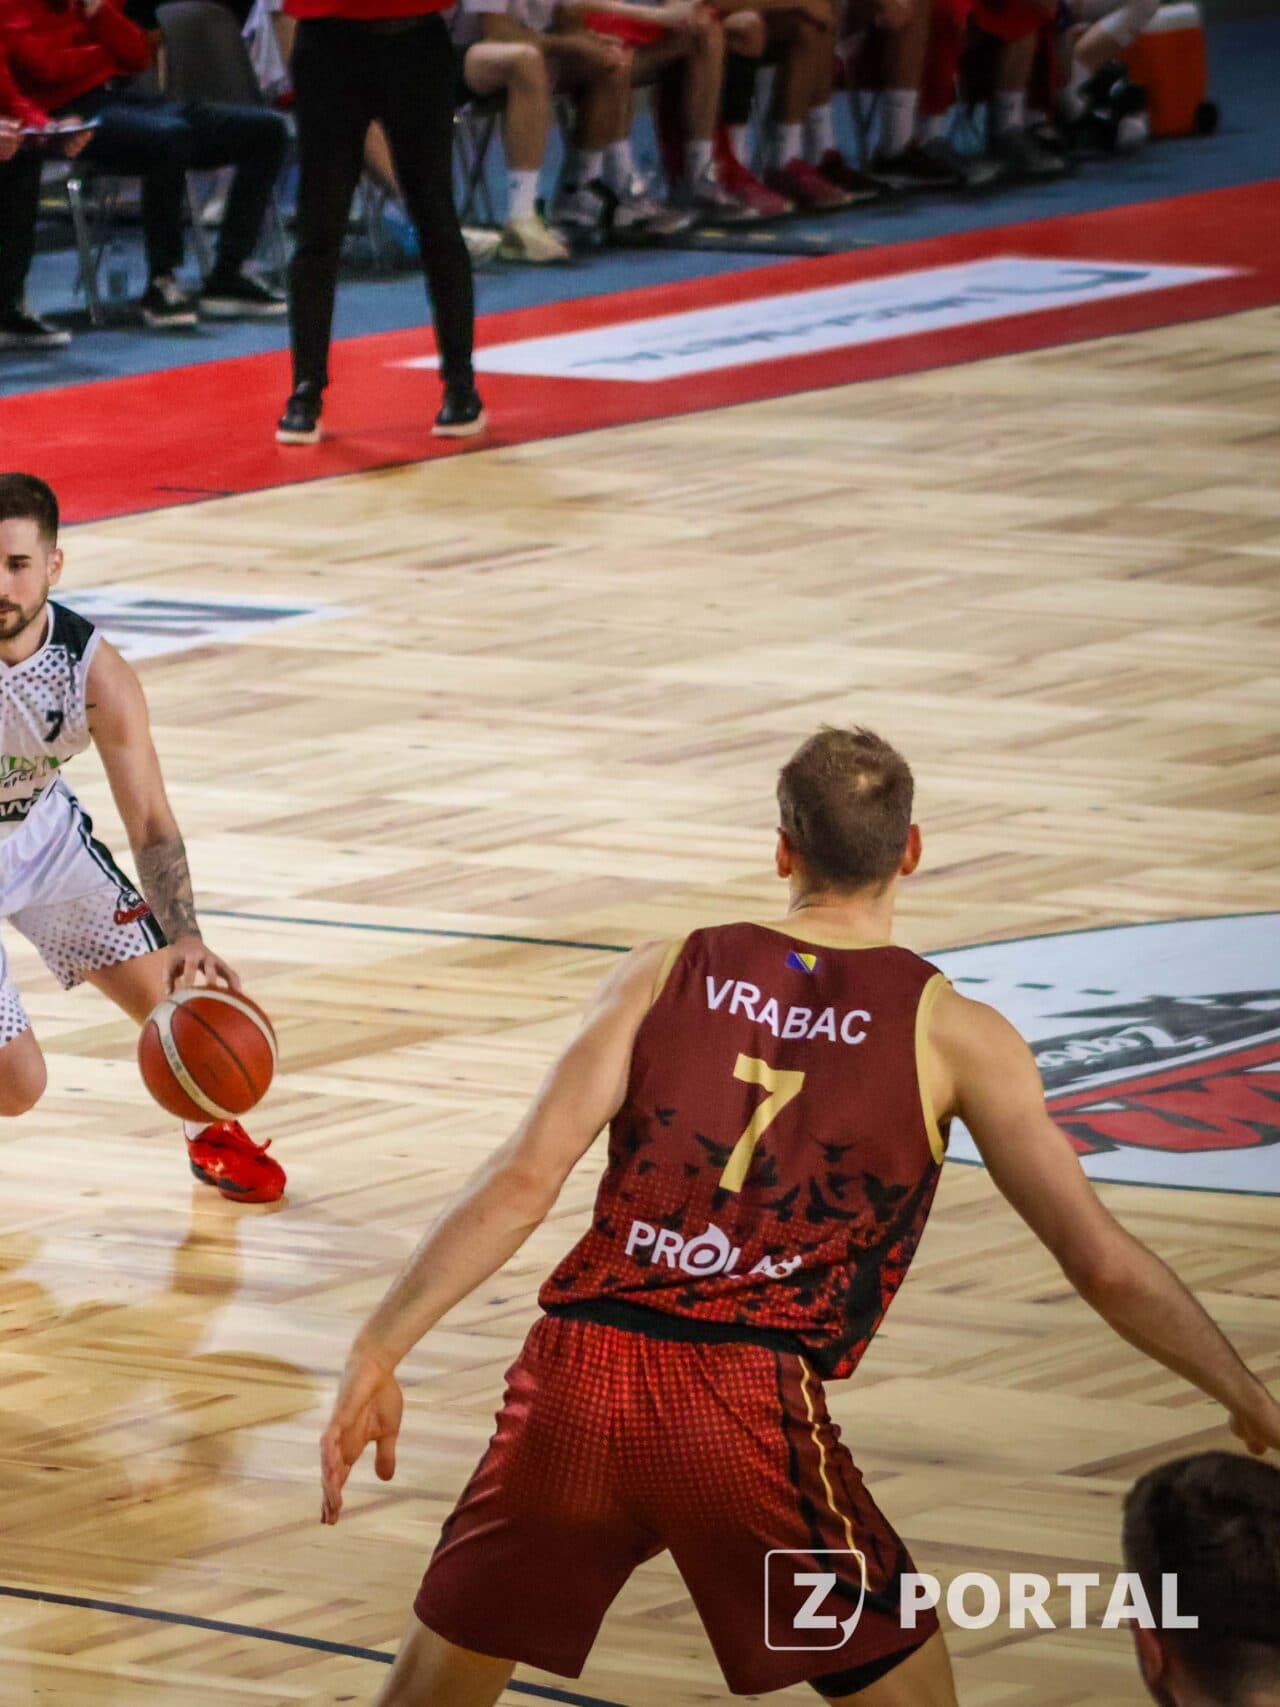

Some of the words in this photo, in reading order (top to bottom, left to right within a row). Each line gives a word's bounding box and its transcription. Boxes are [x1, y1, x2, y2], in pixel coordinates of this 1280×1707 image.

[43, 710, 64, 742] 7
[706, 975, 872, 1045] VRABAC
[719, 1052, 805, 1193] 7
